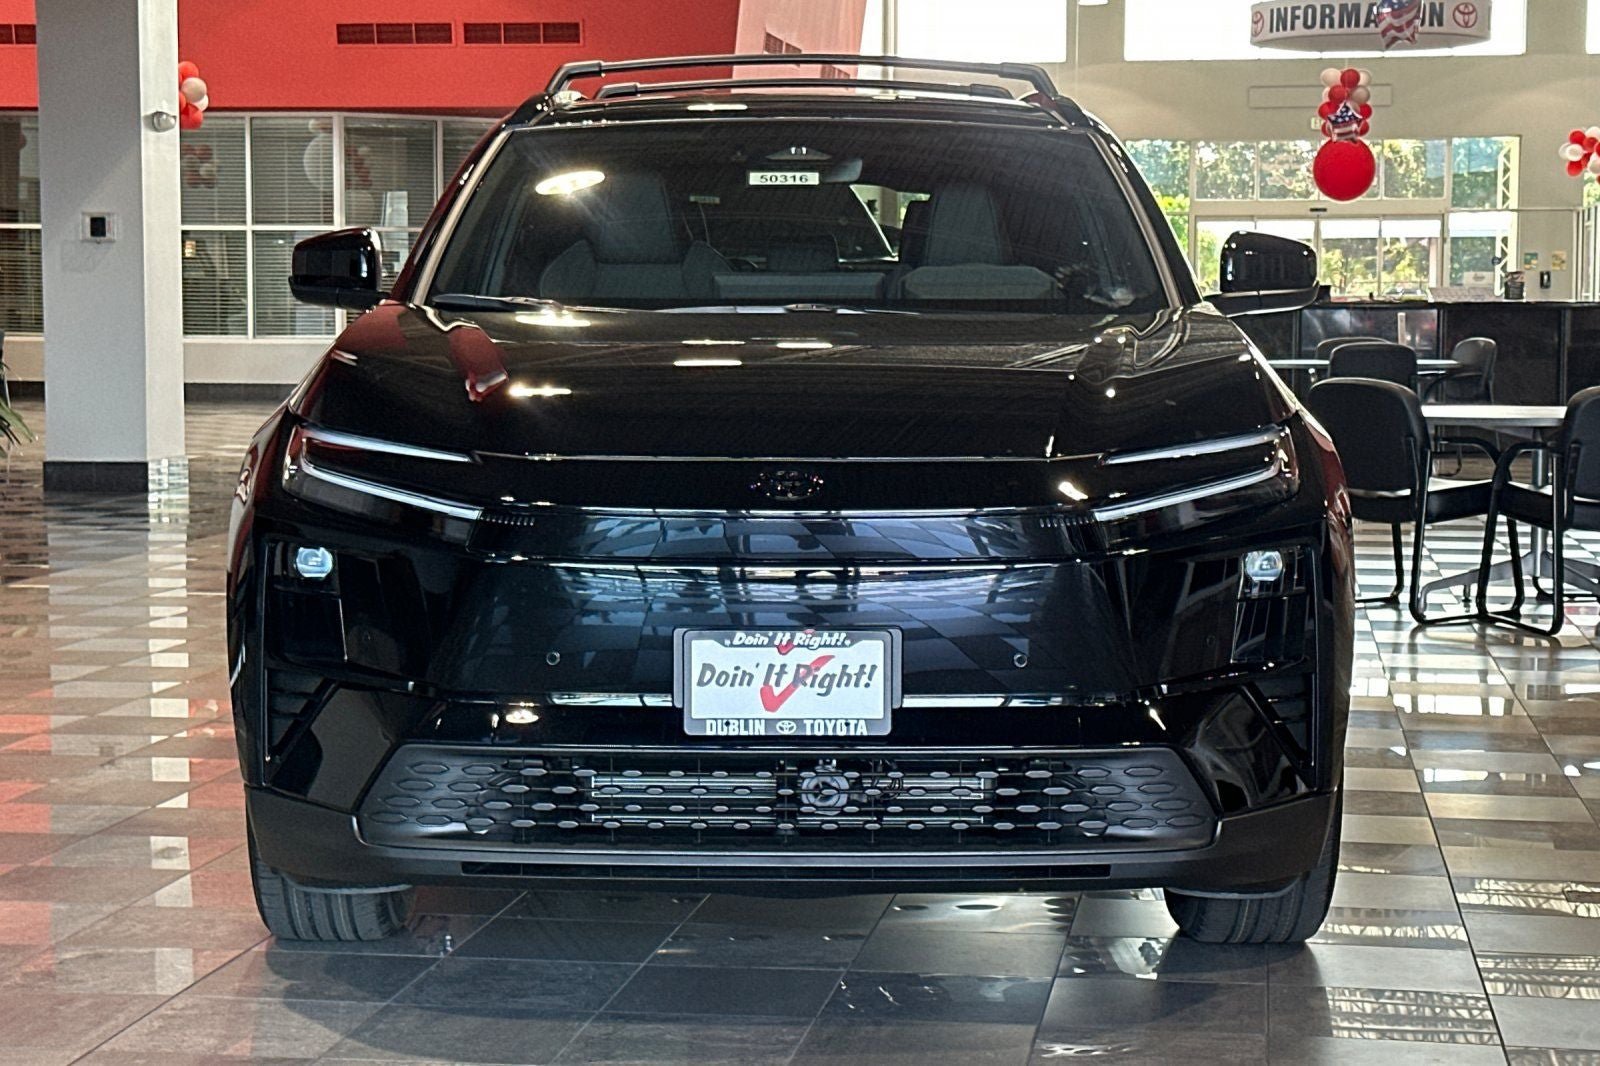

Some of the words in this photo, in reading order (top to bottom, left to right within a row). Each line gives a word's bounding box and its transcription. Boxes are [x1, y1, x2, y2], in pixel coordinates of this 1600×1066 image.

[1269, 2, 1444, 33] INFORMAN
[760, 174, 809, 184] 50316
[732, 631, 773, 646] Doin'
[774, 632, 792, 646] It
[793, 631, 847, 650] Right!
[696, 662, 760, 688] Doin'
[762, 663, 789, 688] It
[792, 663, 878, 697] Right!
[706, 719, 766, 736] DUBLIN
[803, 719, 868, 736] TOYOTA
